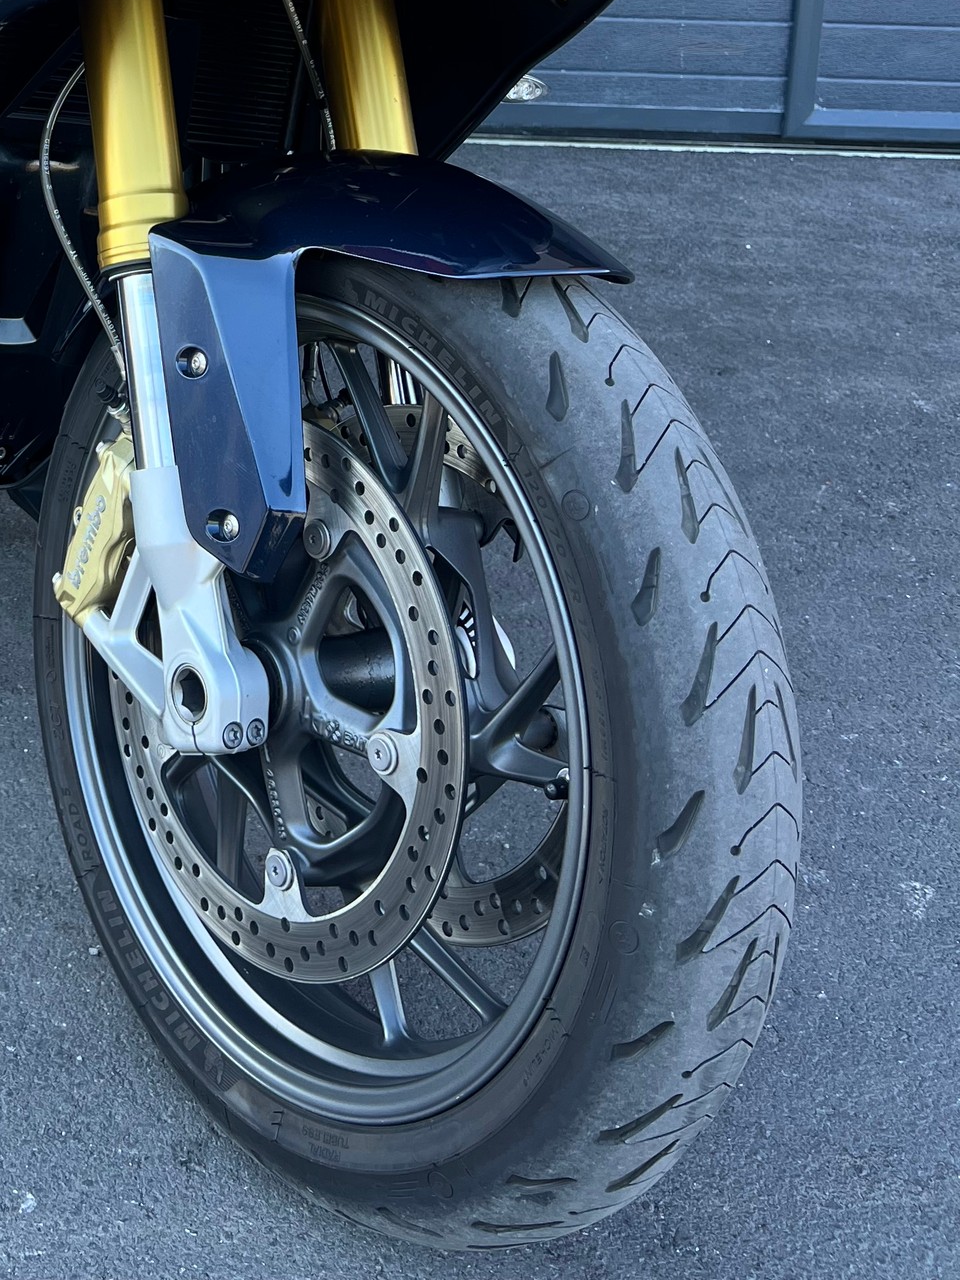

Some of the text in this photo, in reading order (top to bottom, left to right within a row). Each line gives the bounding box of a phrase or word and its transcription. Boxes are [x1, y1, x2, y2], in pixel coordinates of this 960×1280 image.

[361, 292, 500, 422] MICHELIN
[66, 494, 107, 591] brembo
[67, 804, 94, 862] ROAD
[95, 889, 200, 1053] MICHELIN
